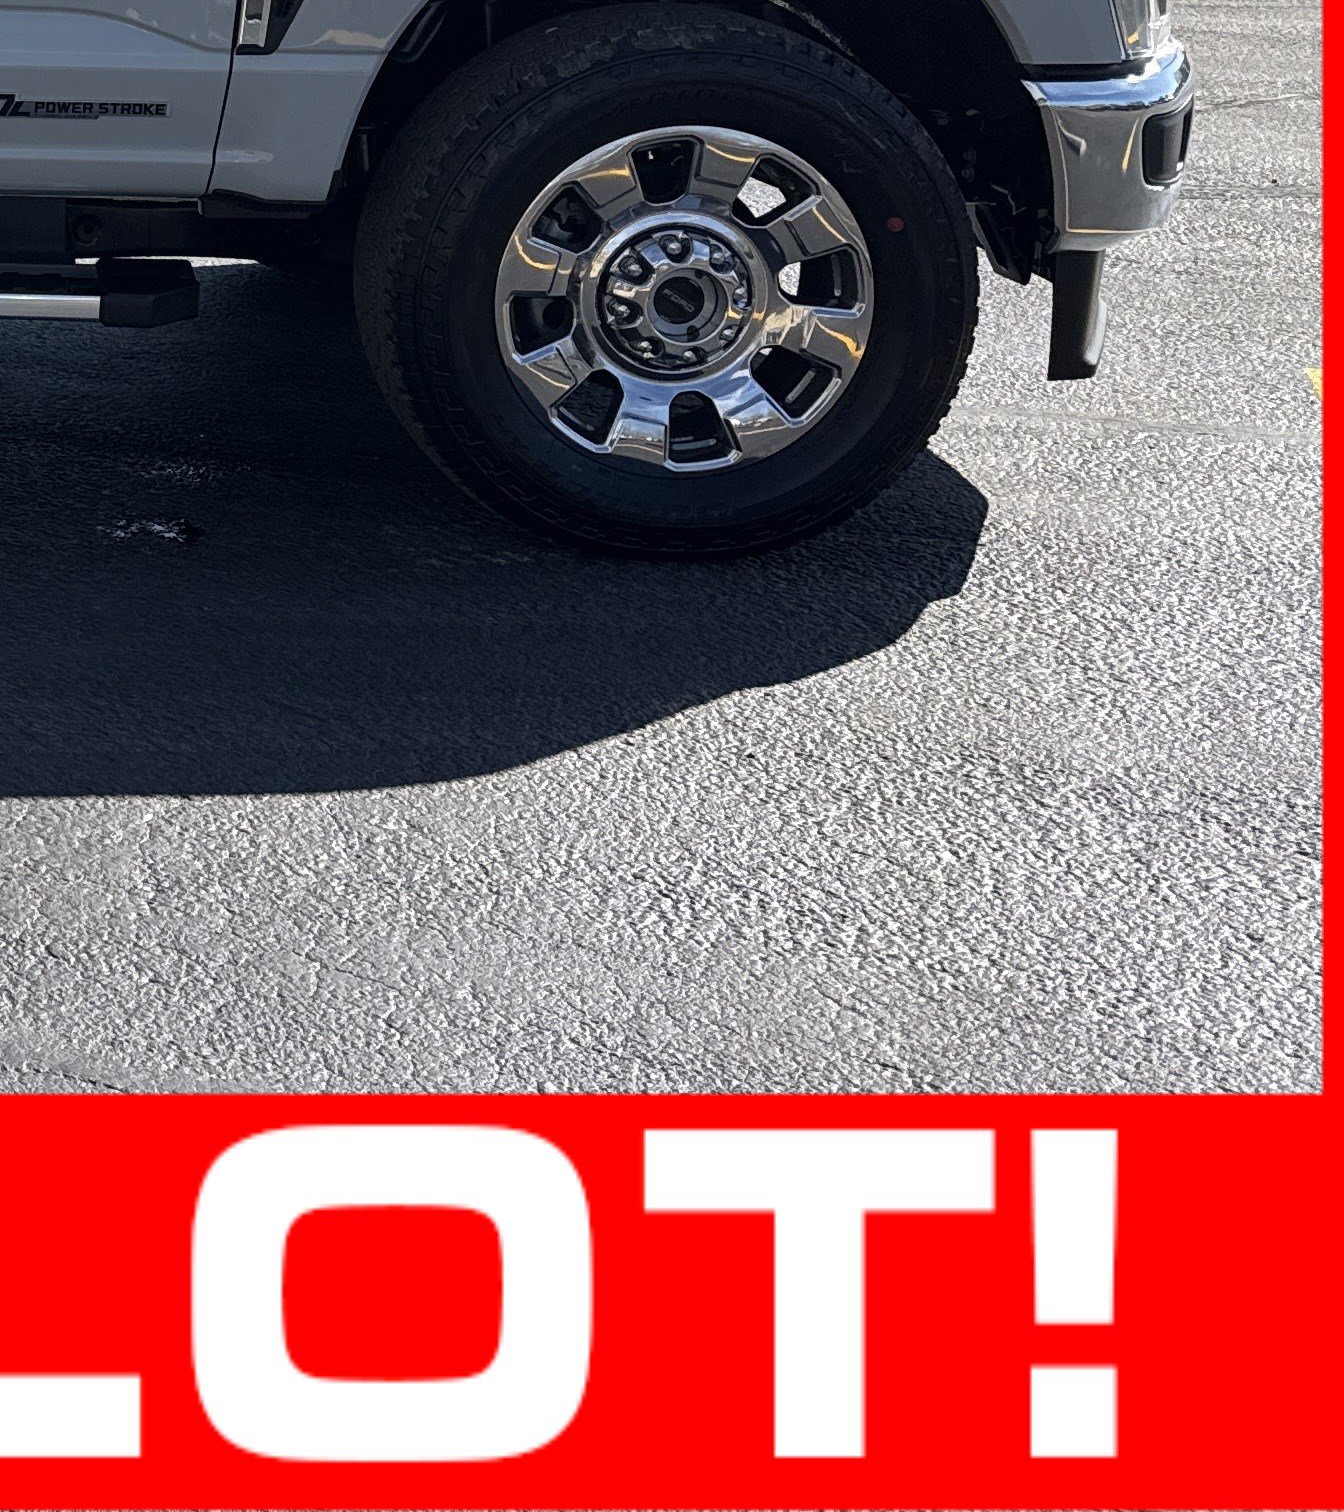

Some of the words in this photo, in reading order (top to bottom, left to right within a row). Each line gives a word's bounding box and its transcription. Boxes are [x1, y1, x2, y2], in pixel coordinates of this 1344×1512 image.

[33, 101, 94, 115] POWER
[98, 102, 168, 116] STROKE
[662, 288, 695, 313] FORD
